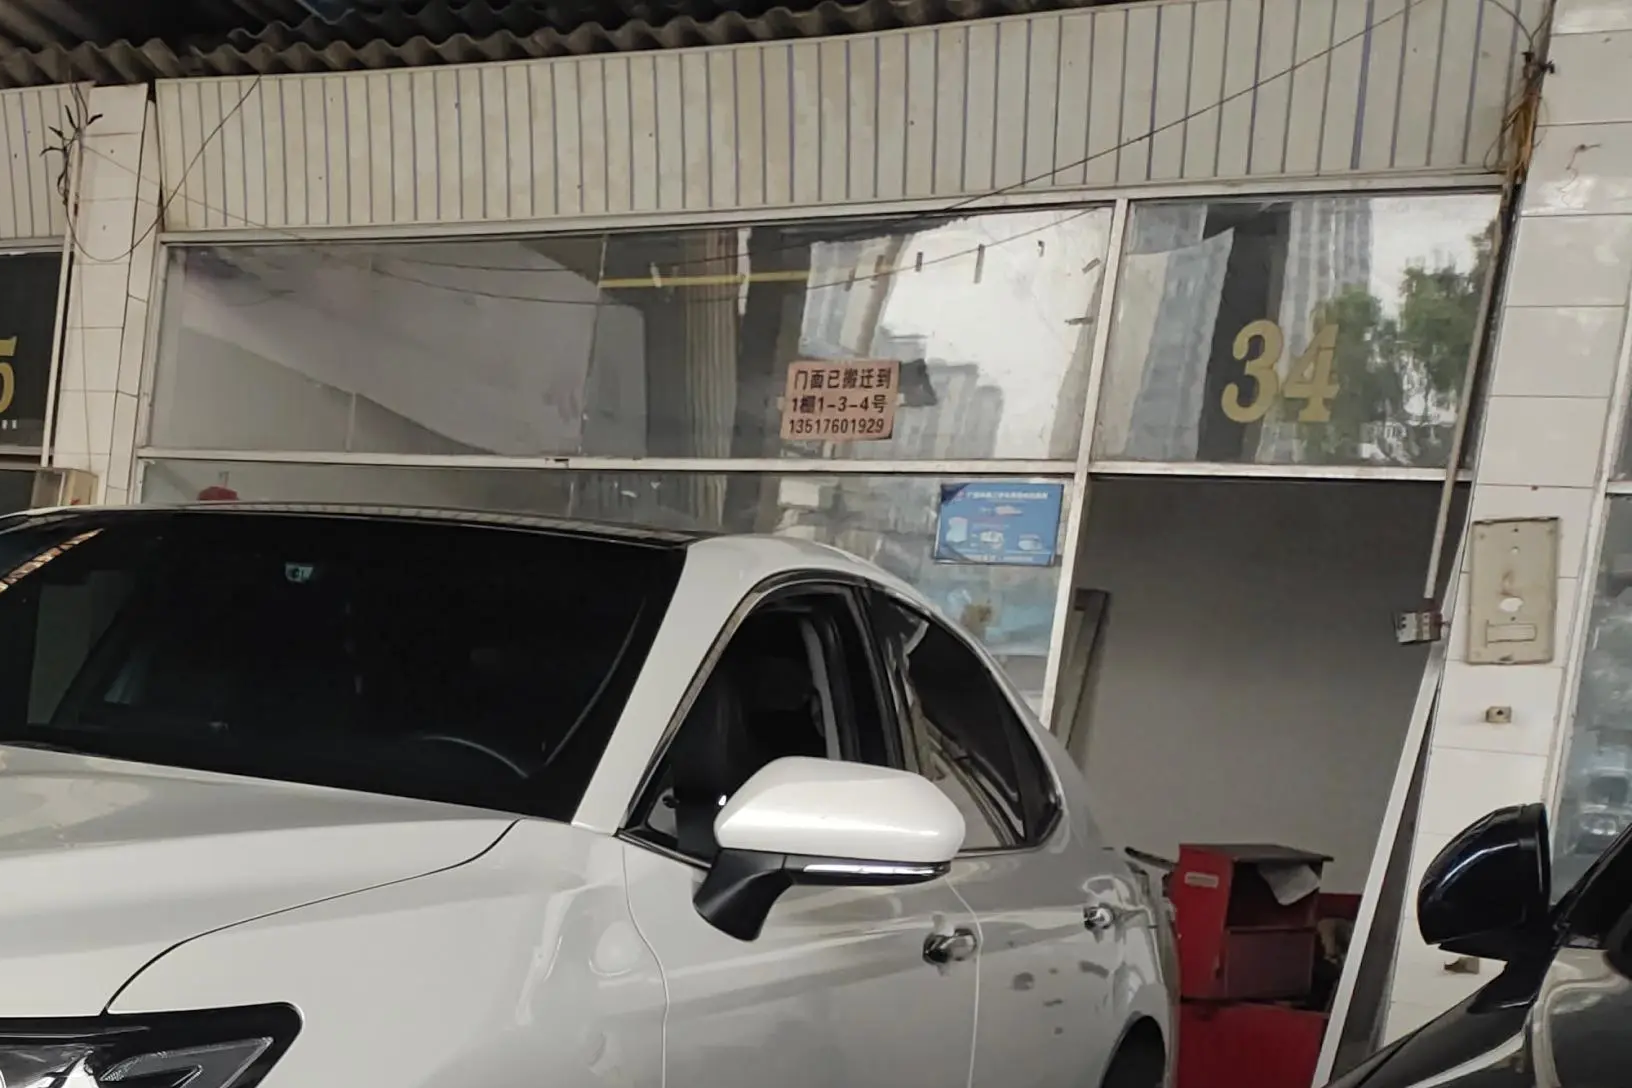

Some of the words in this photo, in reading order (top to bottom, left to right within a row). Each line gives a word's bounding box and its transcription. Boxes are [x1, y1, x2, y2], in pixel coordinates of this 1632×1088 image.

[794, 367, 892, 390] 门面已搬迁到
[1221, 319, 1340, 423] 34
[788, 418, 885, 434] 13517601929
